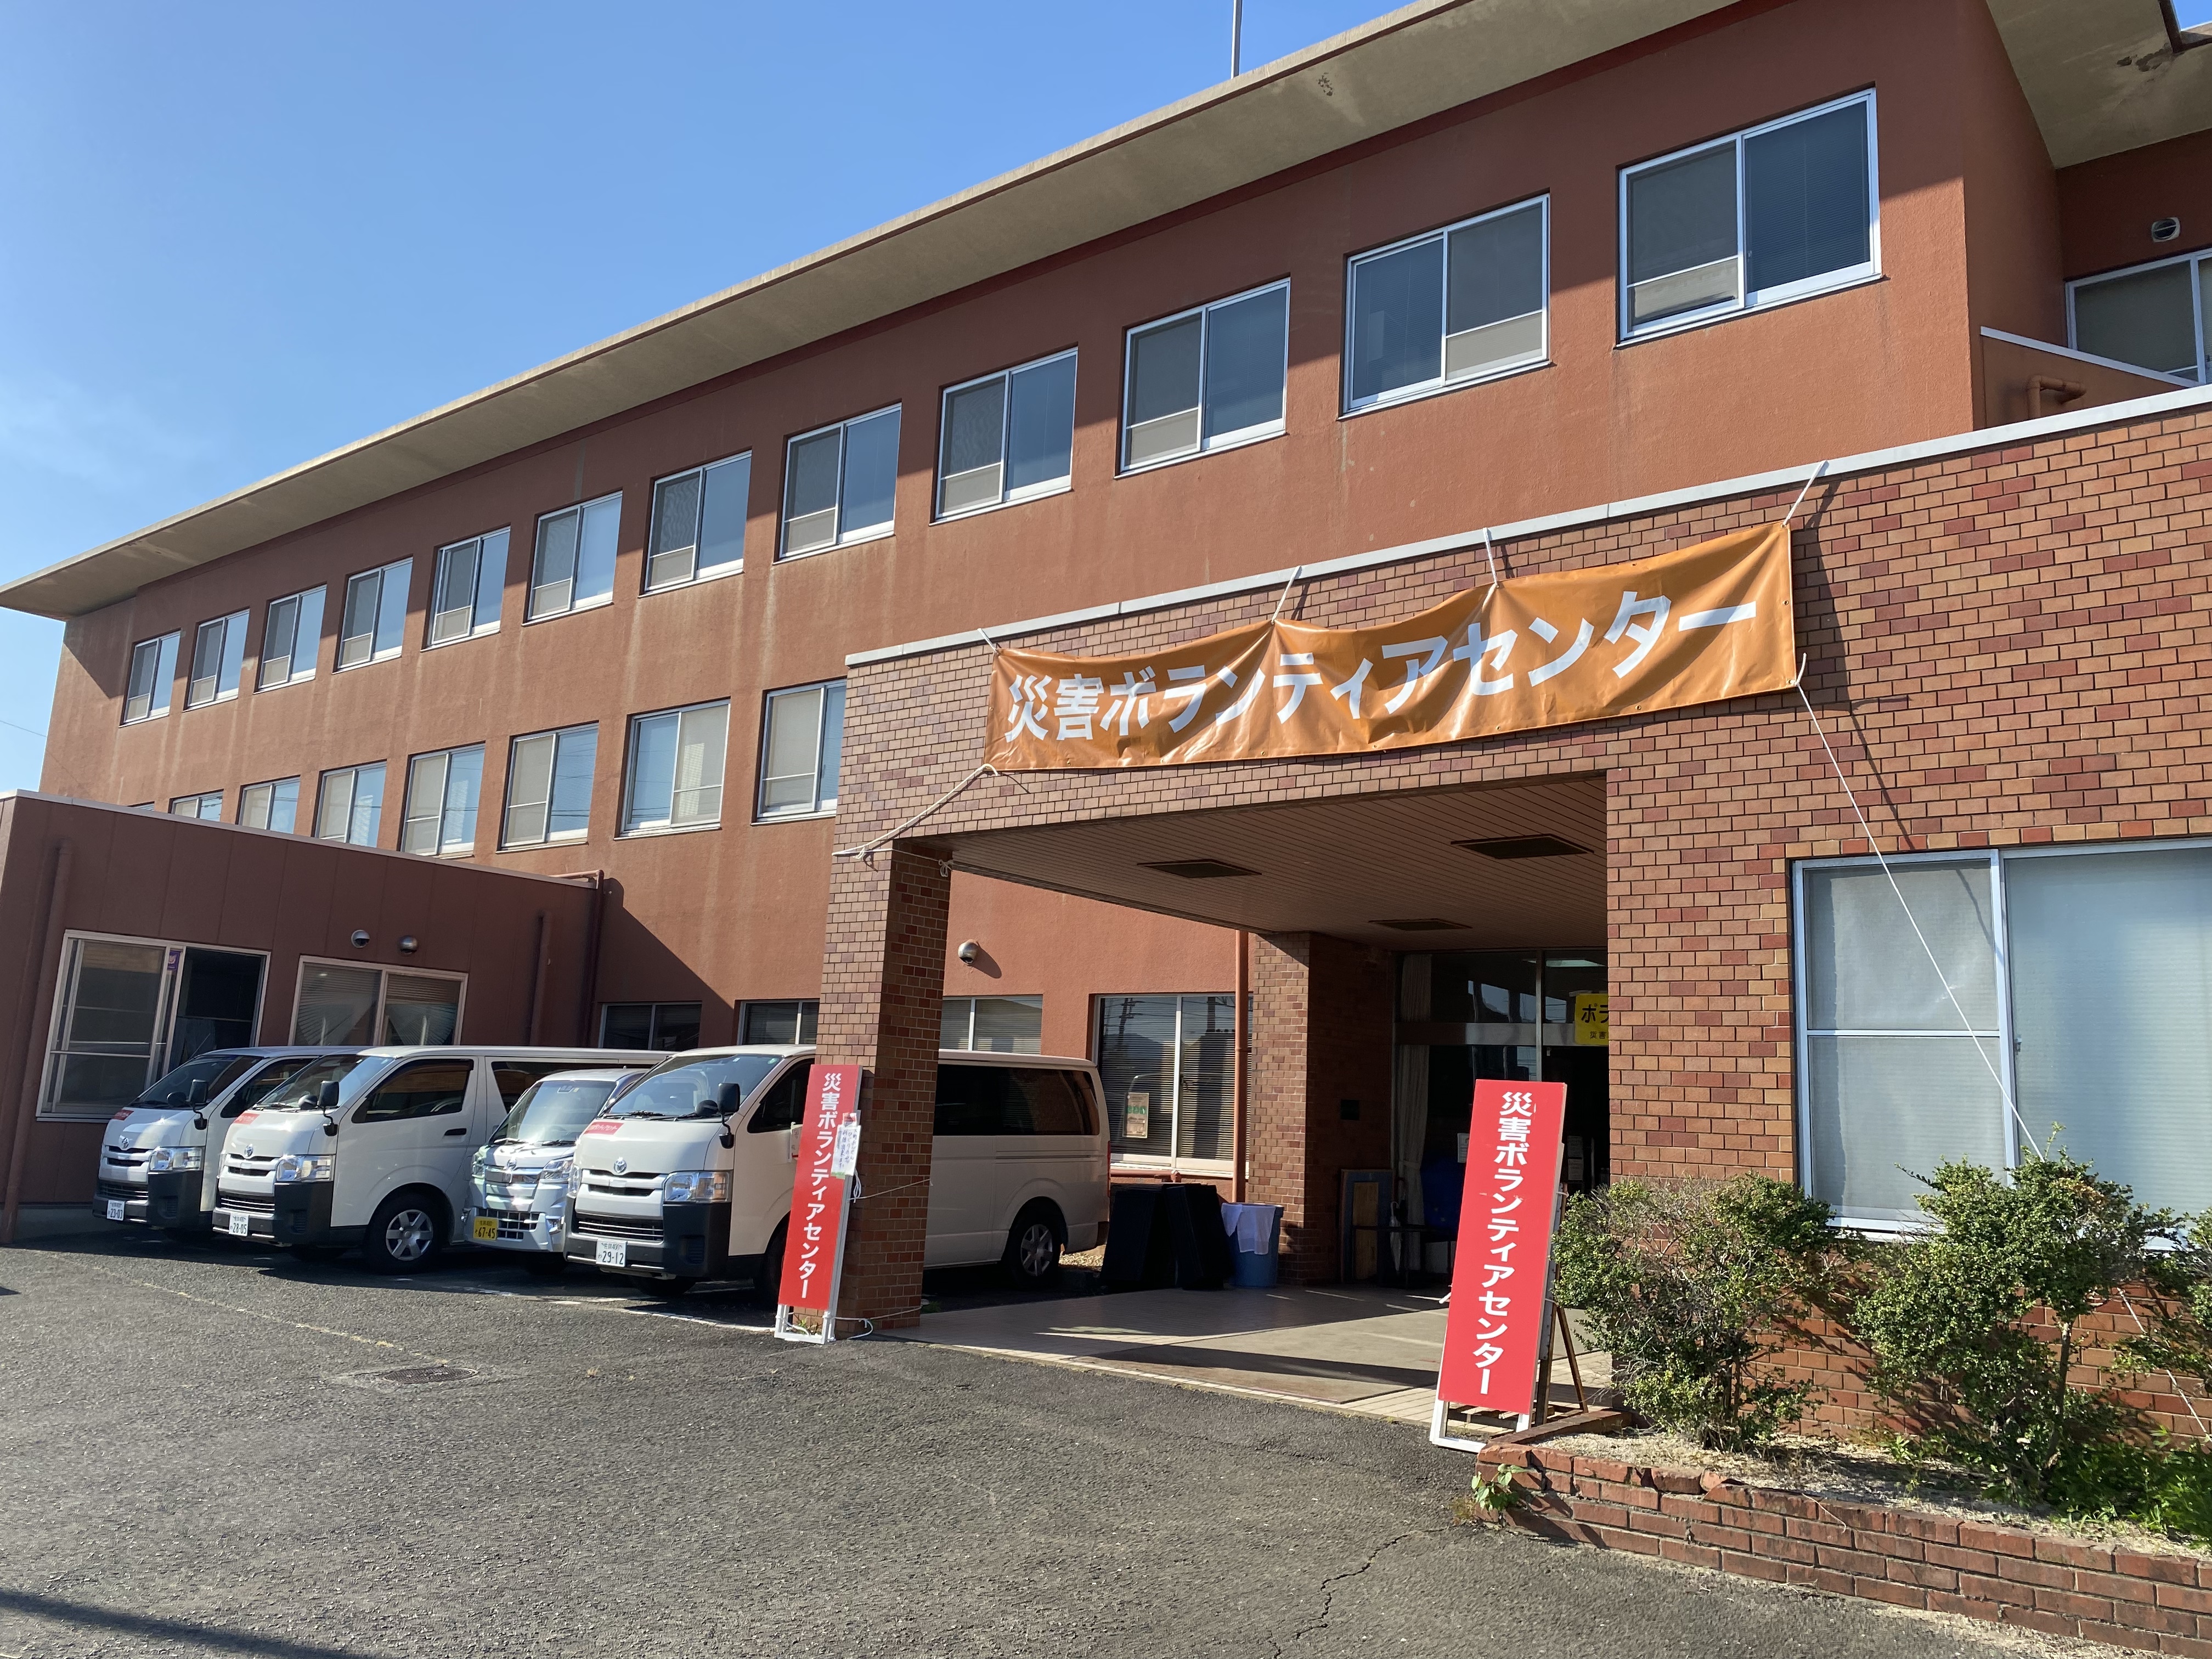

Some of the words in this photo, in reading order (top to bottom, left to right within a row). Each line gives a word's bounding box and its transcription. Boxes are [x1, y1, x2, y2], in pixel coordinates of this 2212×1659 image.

[1005, 590, 1756, 742] 災害ボランティアセンター
[478, 1227, 495, 1238] 67-45
[602, 1250, 623, 1265] 29-12
[798, 1072, 842, 1299] 災害ボランティアセンター
[1472, 1091, 1533, 1395] 災害ボランティアセンター
